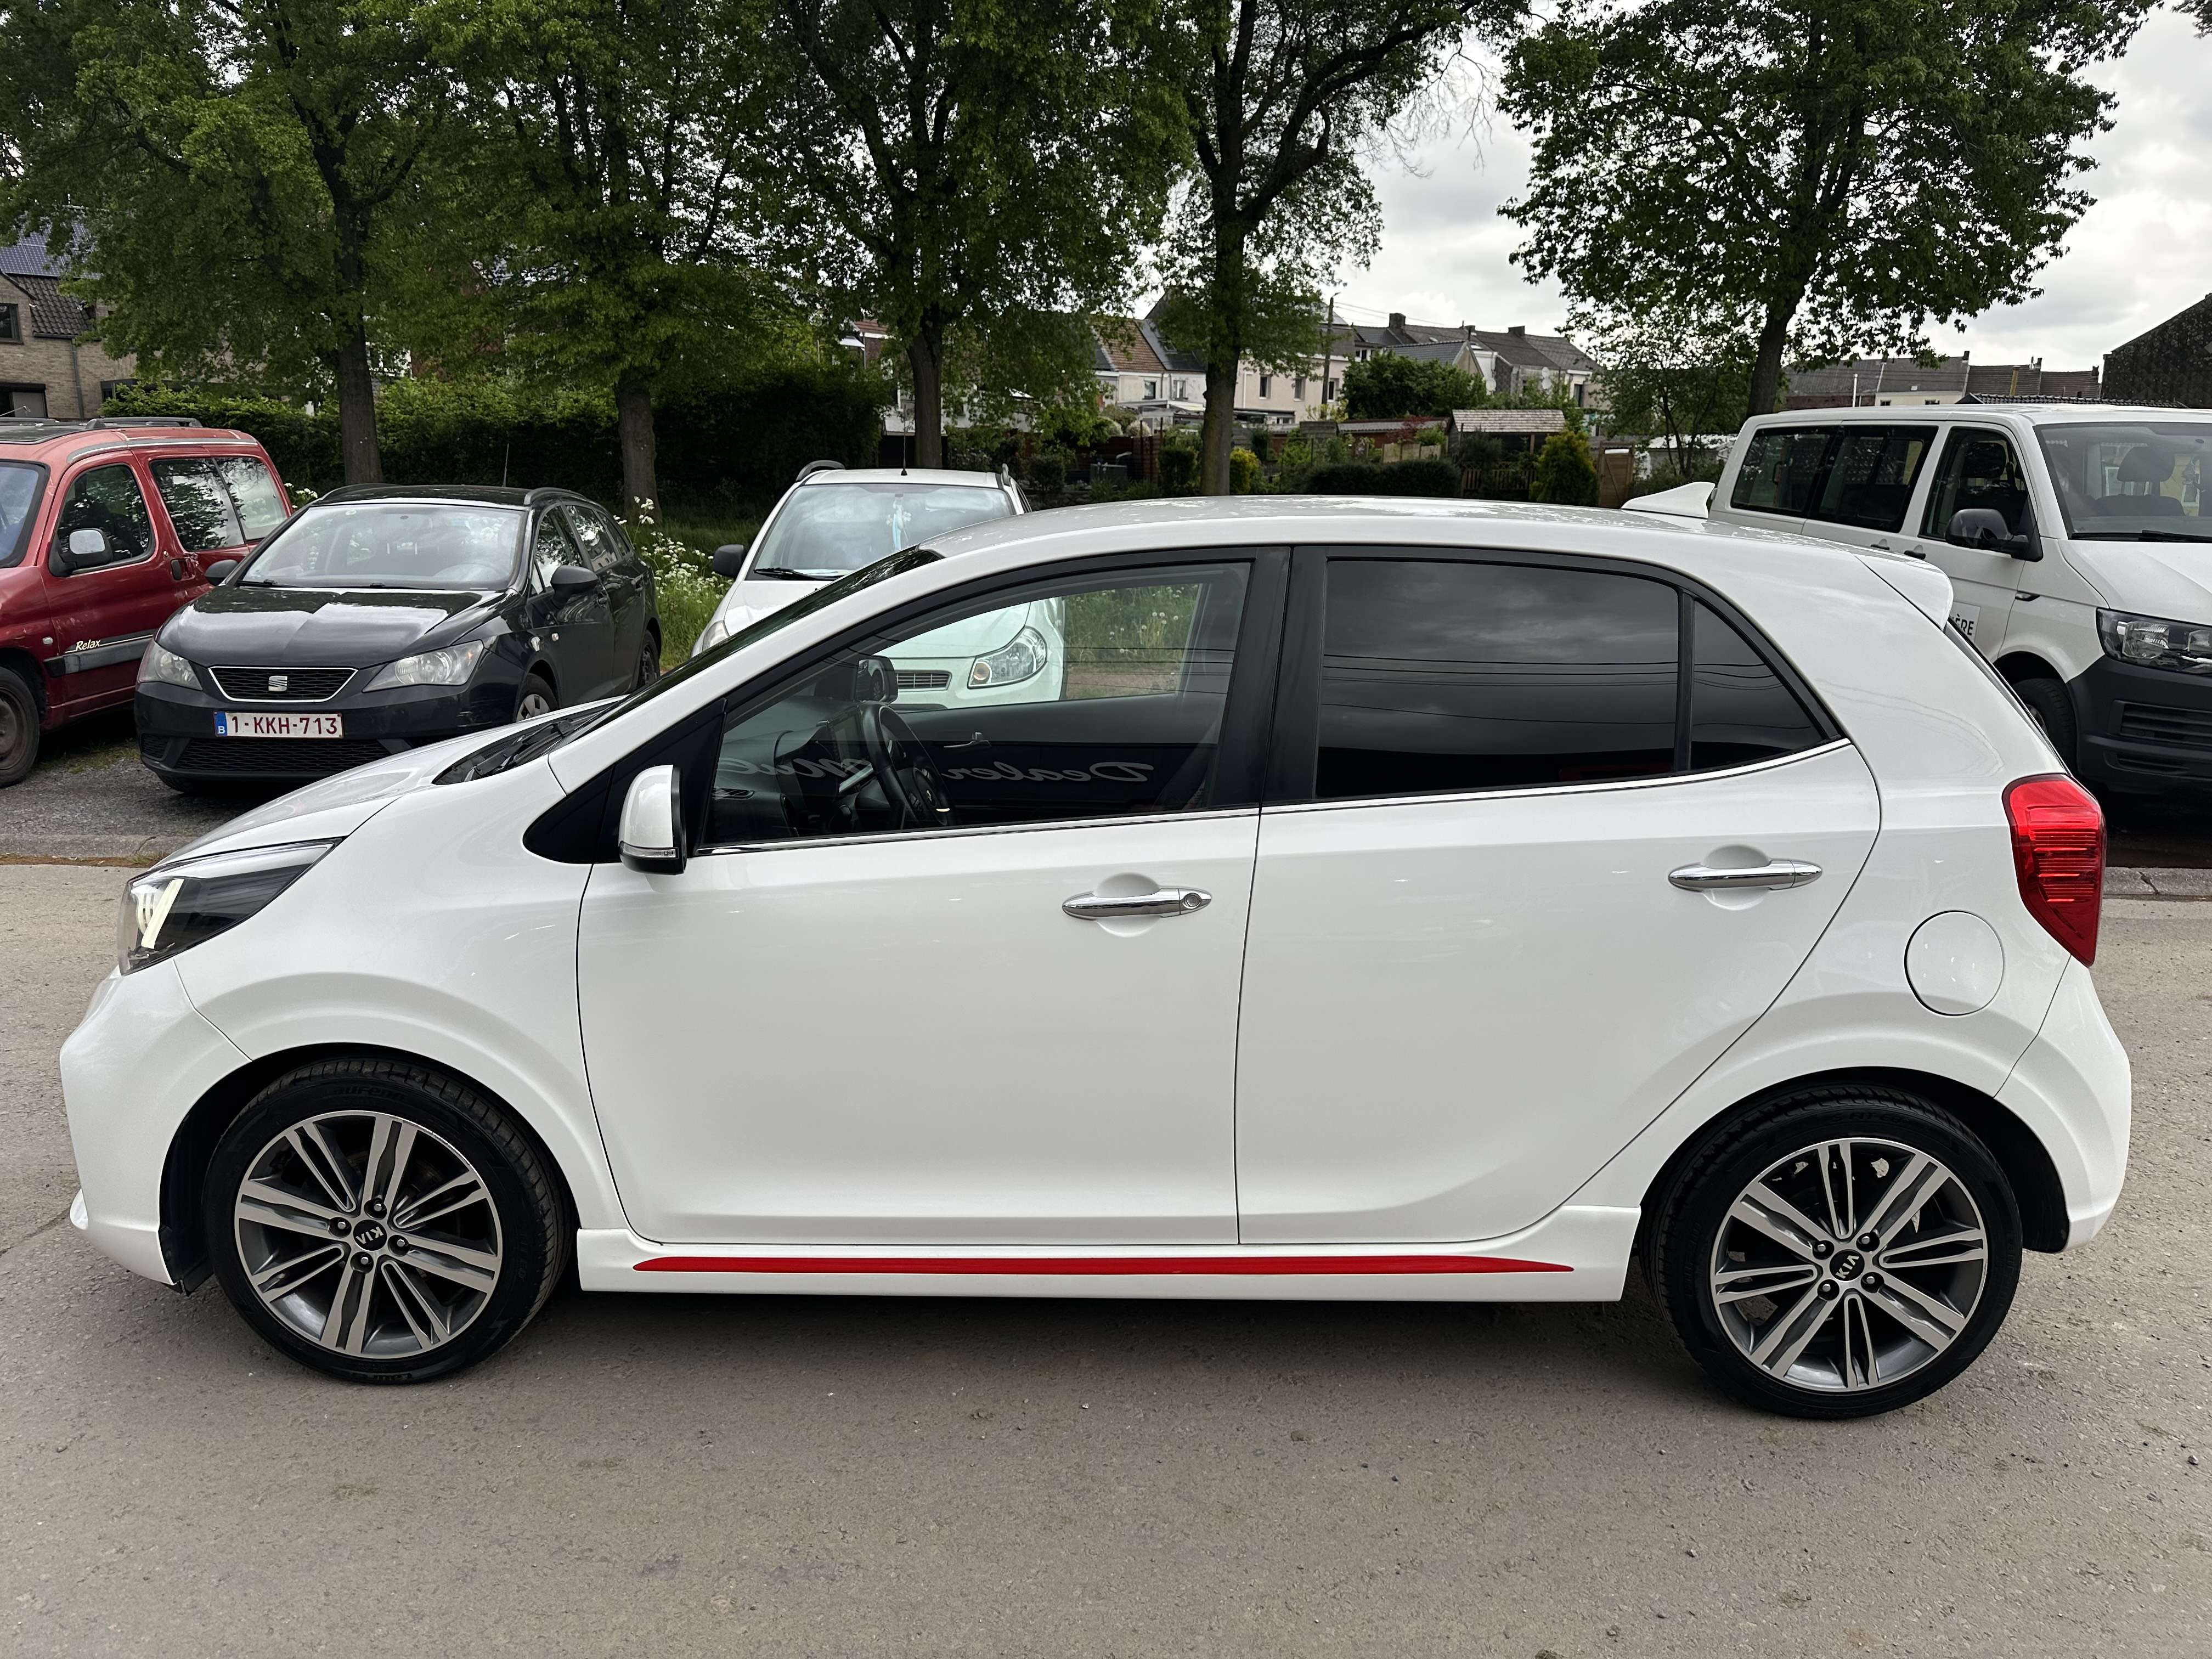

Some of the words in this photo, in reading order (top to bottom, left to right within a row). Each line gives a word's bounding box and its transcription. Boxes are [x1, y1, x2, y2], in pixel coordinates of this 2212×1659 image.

[76, 639, 100, 651] Relax
[232, 716, 337, 734] 1-KKH-713
[356, 1226, 383, 1244] KIA
[1835, 1255, 1859, 1279] KIA
